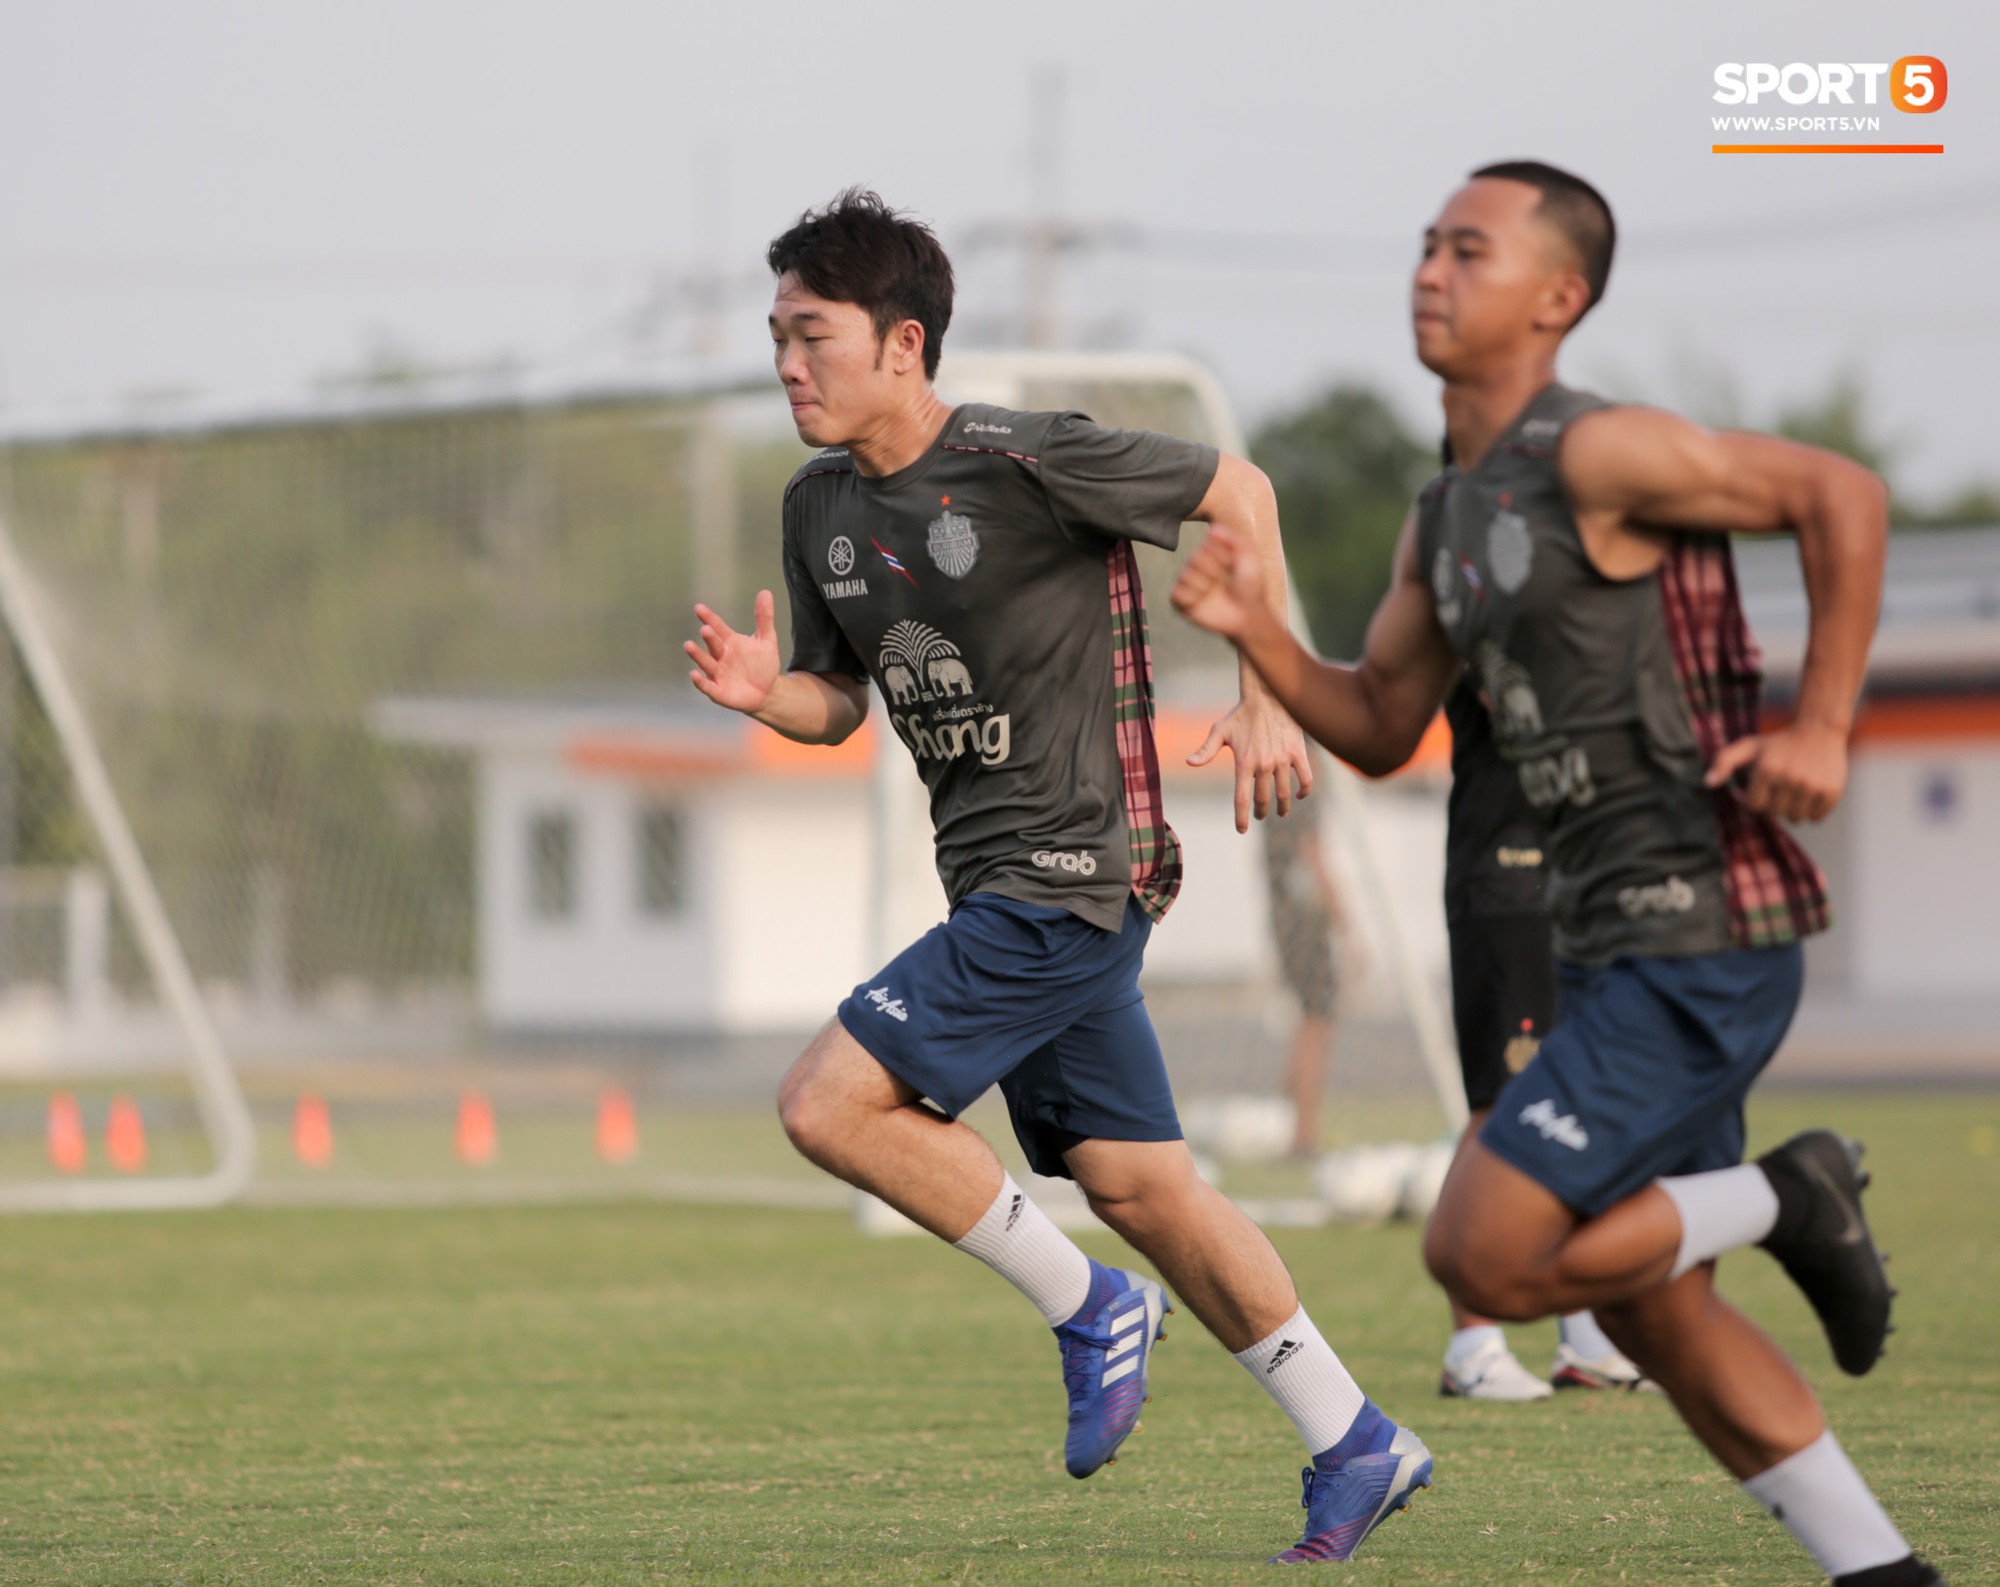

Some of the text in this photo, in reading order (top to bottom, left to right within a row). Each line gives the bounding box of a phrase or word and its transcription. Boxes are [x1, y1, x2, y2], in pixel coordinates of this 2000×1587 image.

[822, 578, 869, 600] YAMAHA
[891, 712, 1011, 766] Chang
[1031, 849, 1097, 876] Grab
[1266, 1341, 1304, 1374] adidas
